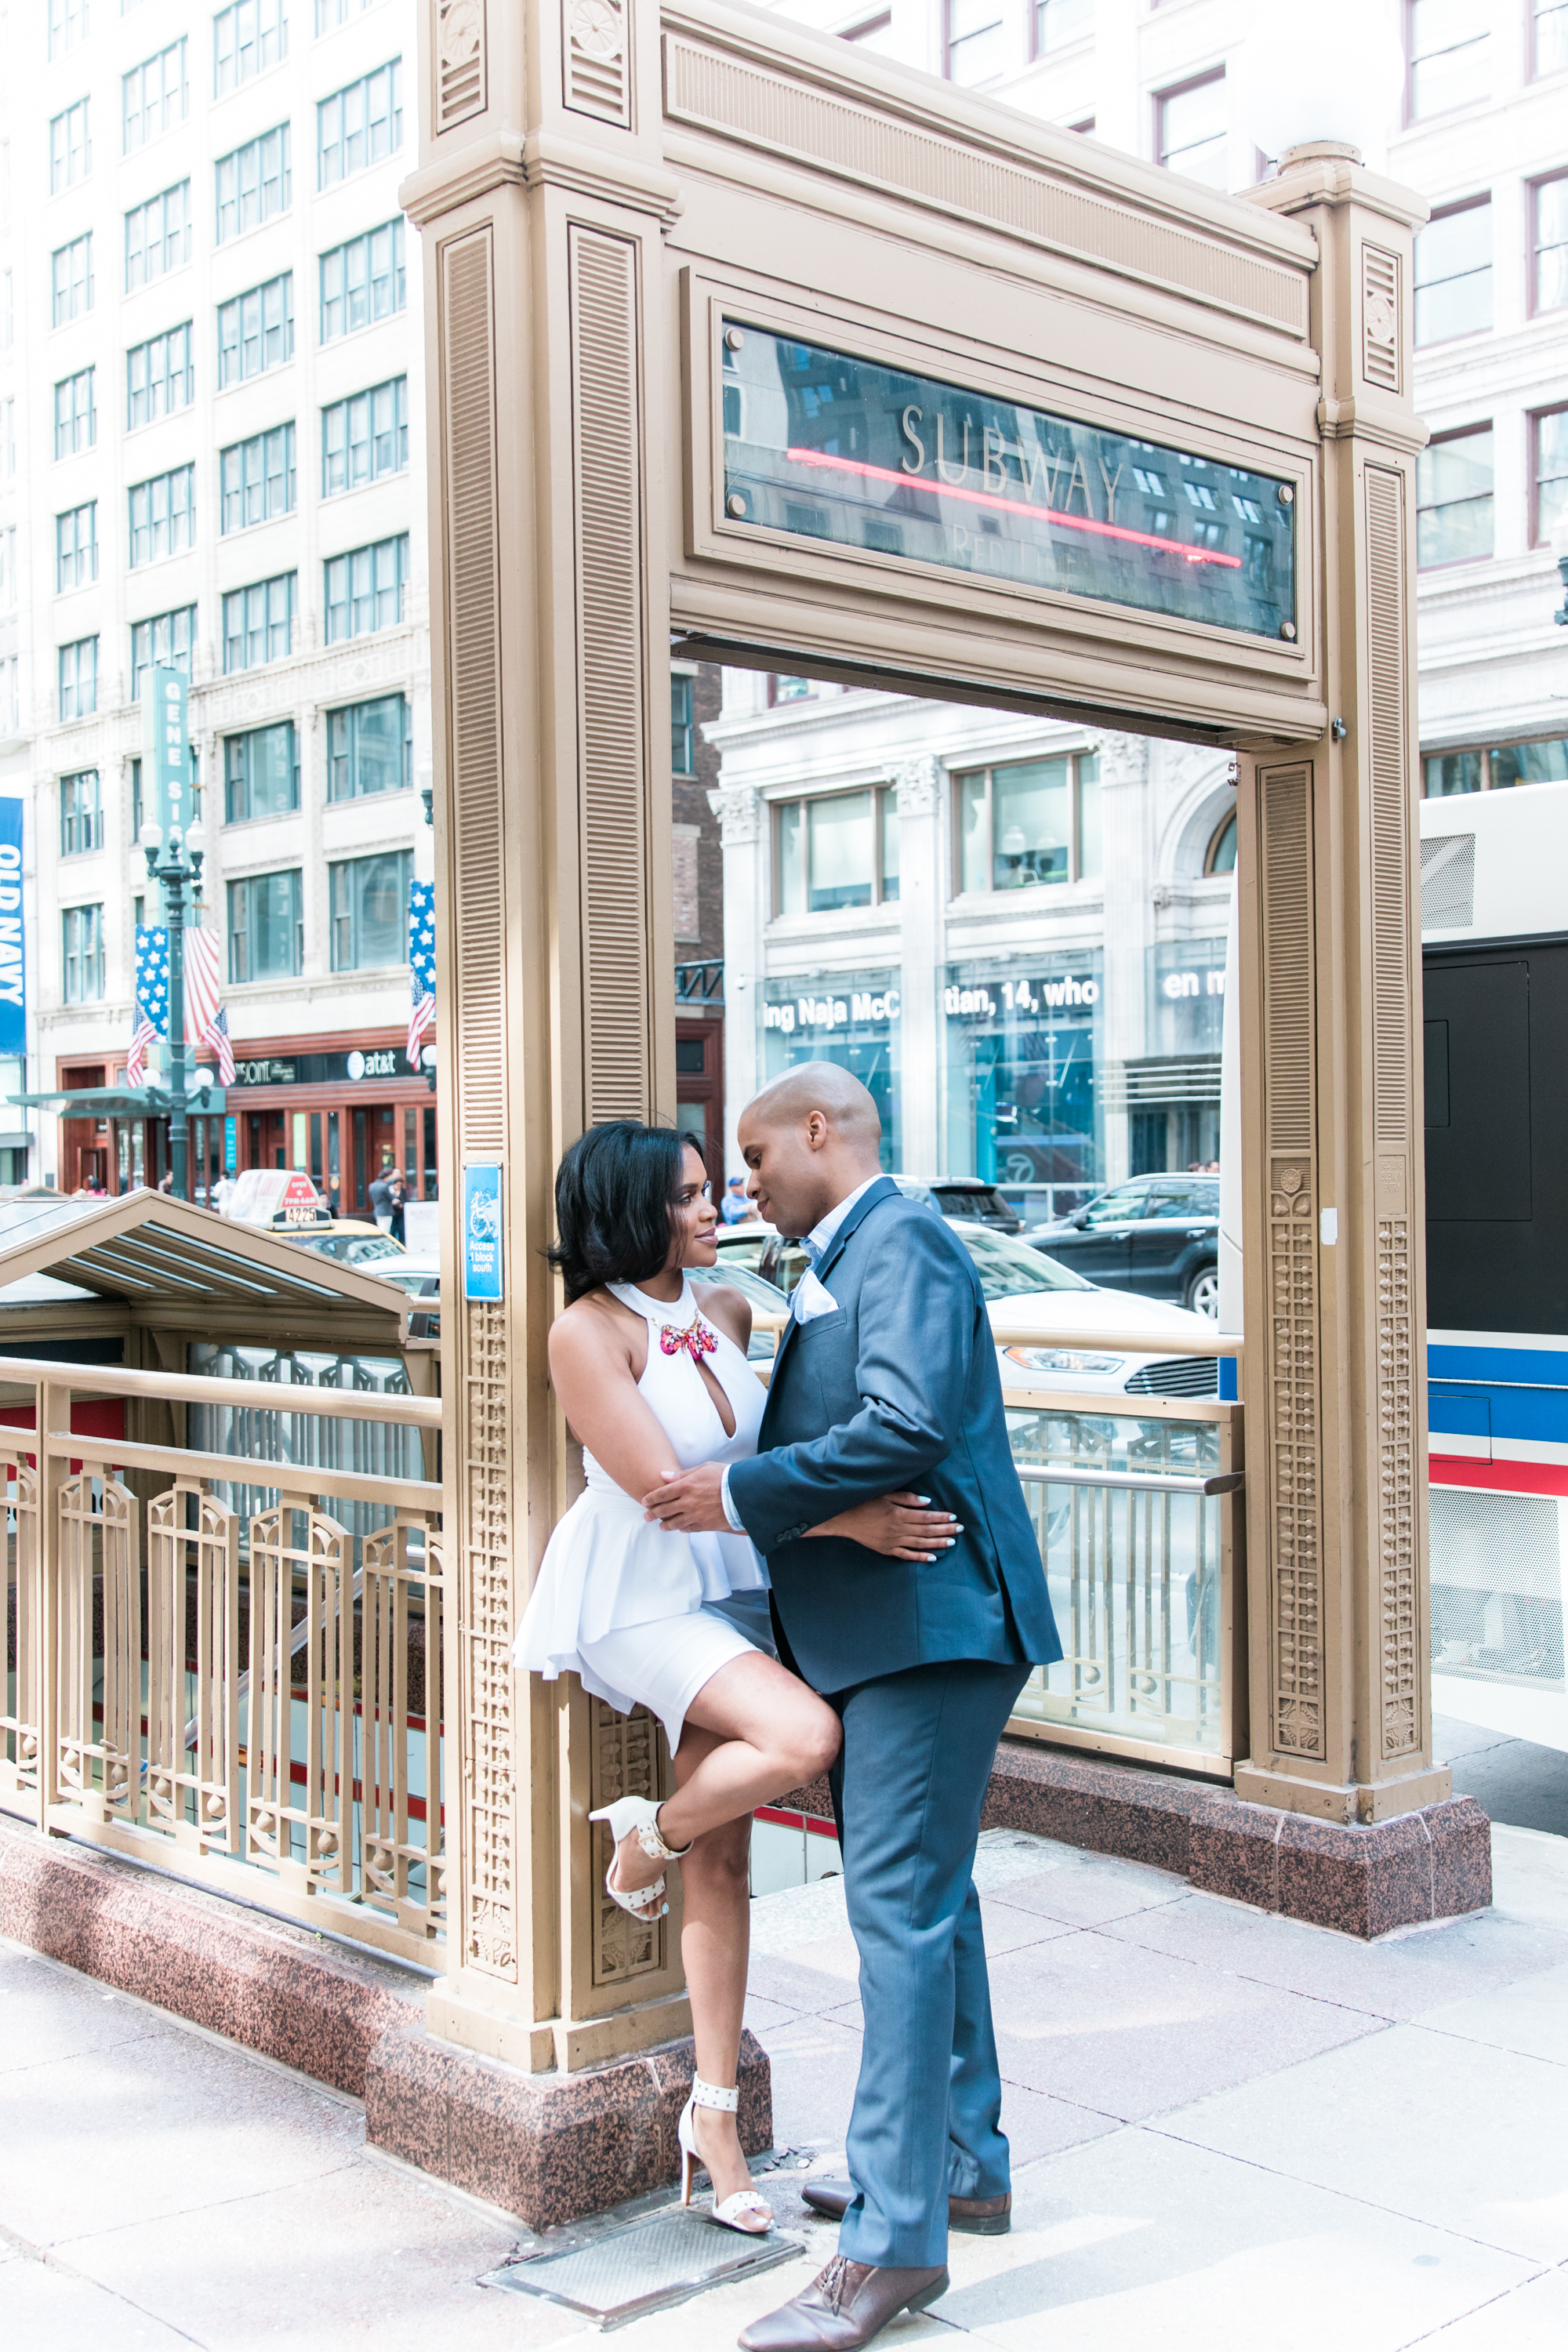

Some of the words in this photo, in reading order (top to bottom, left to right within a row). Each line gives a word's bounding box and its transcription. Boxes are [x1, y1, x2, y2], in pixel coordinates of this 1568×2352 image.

[902, 404, 1123, 523] SUBWAY
[164, 681, 183, 768] GENE
[0, 844, 21, 911] OLD
[0, 916, 24, 1007] NAVY
[763, 1001, 795, 1033] ing
[798, 995, 848, 1030] Naja
[851, 989, 901, 1022] McC
[944, 985, 996, 1017] tian,
[1001, 980, 1039, 1014] 14,
[1043, 975, 1099, 1007] who
[1163, 973, 1200, 999] en
[365, 1050, 396, 1075] at&t
[289, 1207, 315, 1221] 4225
[469, 1240, 495, 1251] Access
[470, 1251, 474, 1261] 1
[474, 1251, 495, 1262] block
[472, 1262, 492, 1272] south
